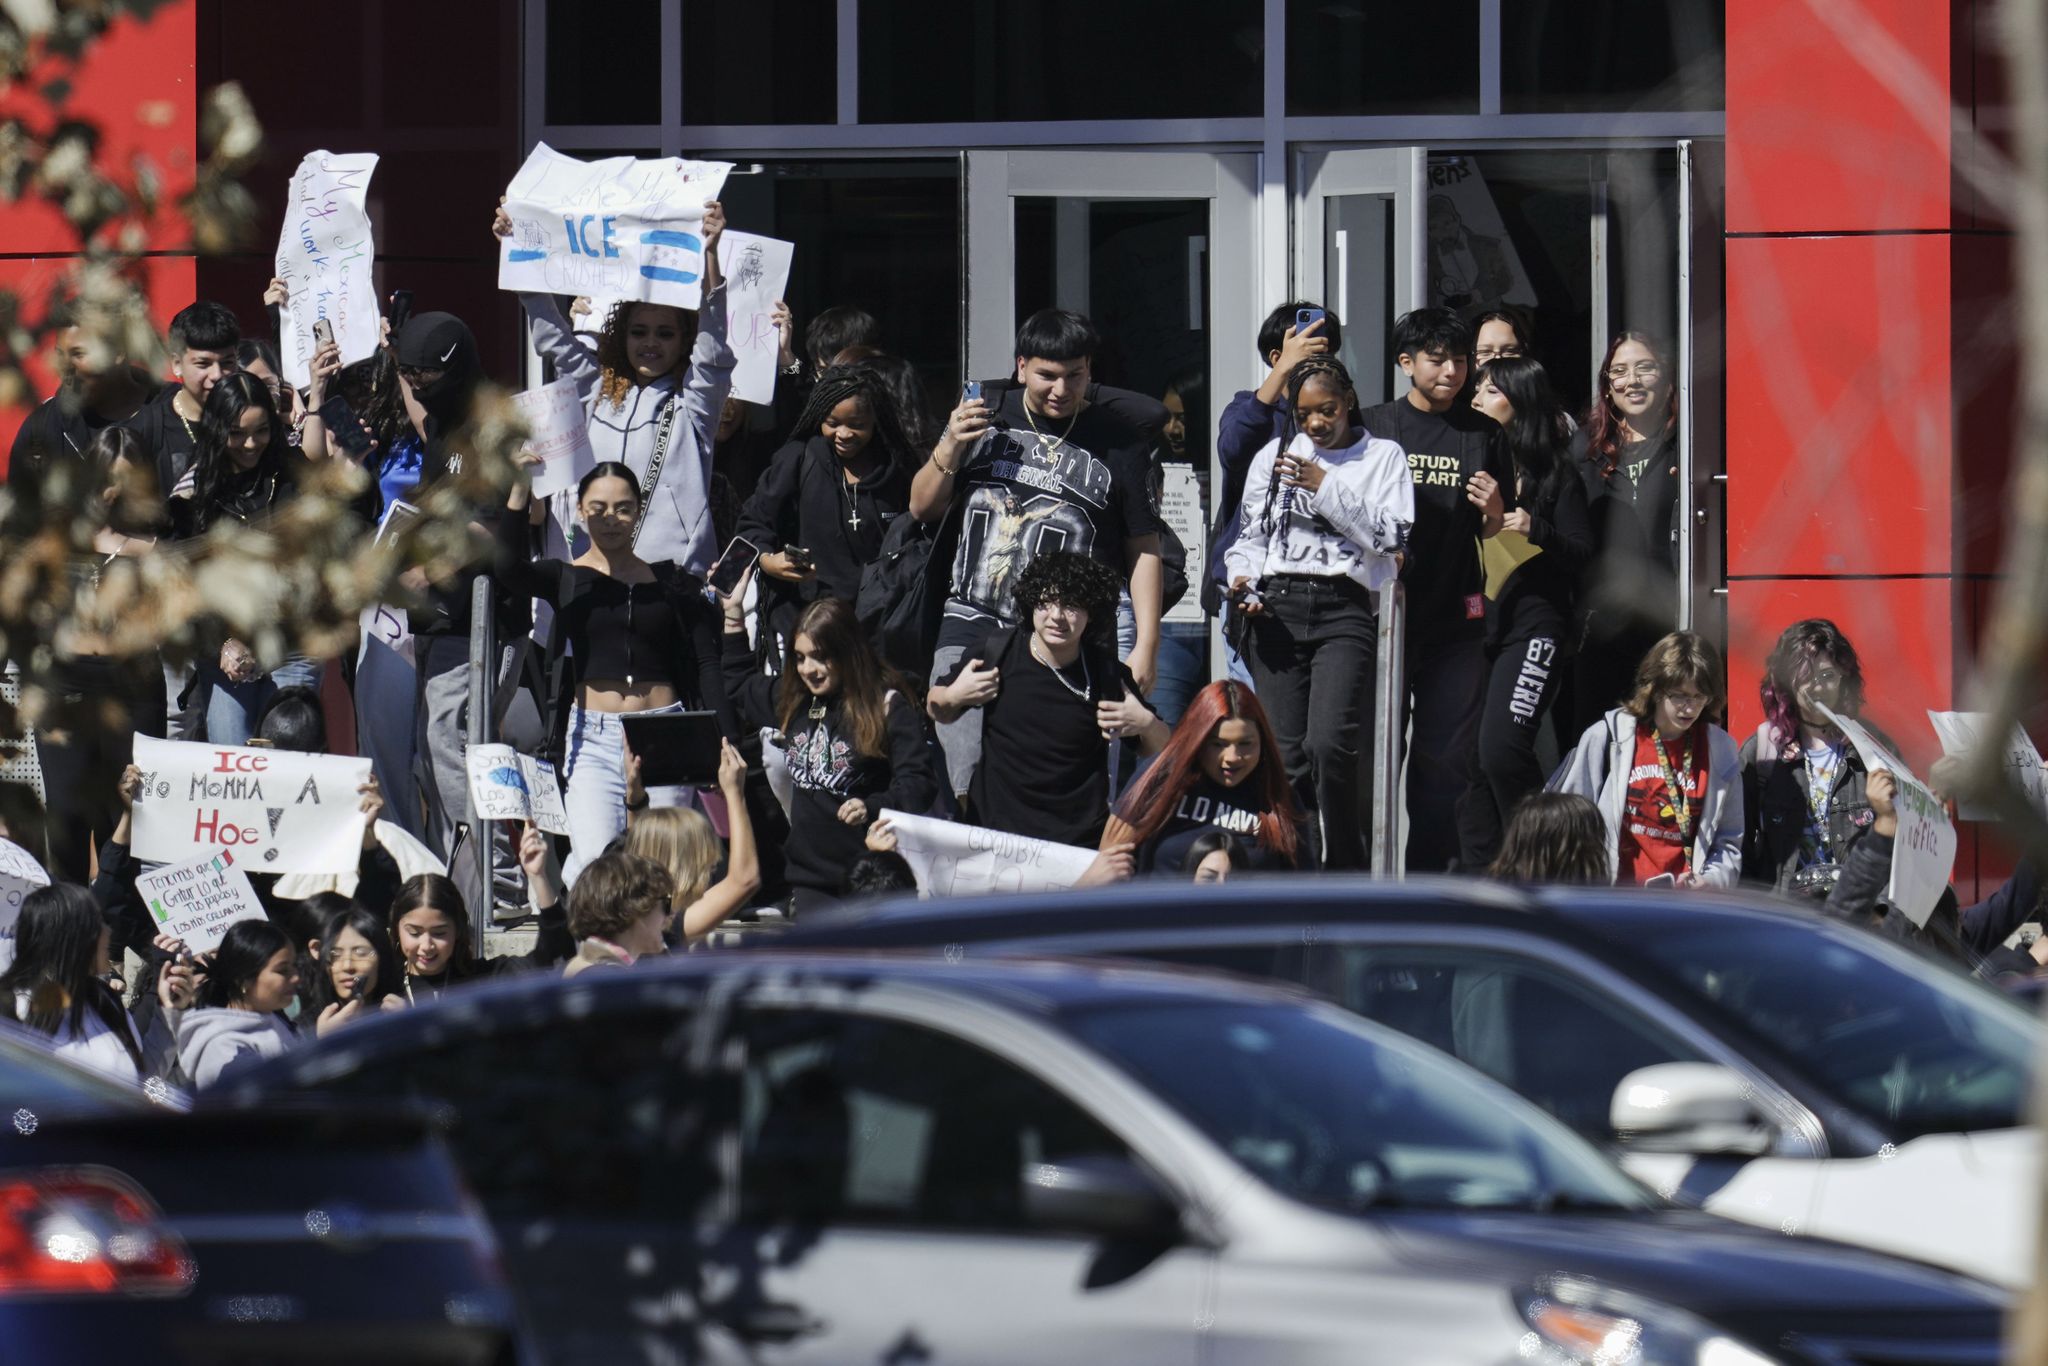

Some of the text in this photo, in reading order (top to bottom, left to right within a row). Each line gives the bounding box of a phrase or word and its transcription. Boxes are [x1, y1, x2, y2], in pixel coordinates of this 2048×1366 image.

[562, 213, 621, 259] ICE
[543, 251, 632, 293] CRUSHED
[652, 435, 667, 463] POLO
[1407, 453, 1460, 471] STUDY
[991, 459, 1063, 494] ORIGINAL
[1526, 638, 1557, 667] 87
[1509, 660, 1551, 718] AERO
[213, 751, 269, 773] Ice
[141, 771, 171, 799] Yo
[295, 773, 321, 804] A
[1176, 794, 1211, 822] LD
[967, 826, 1049, 869] GOODBYE
